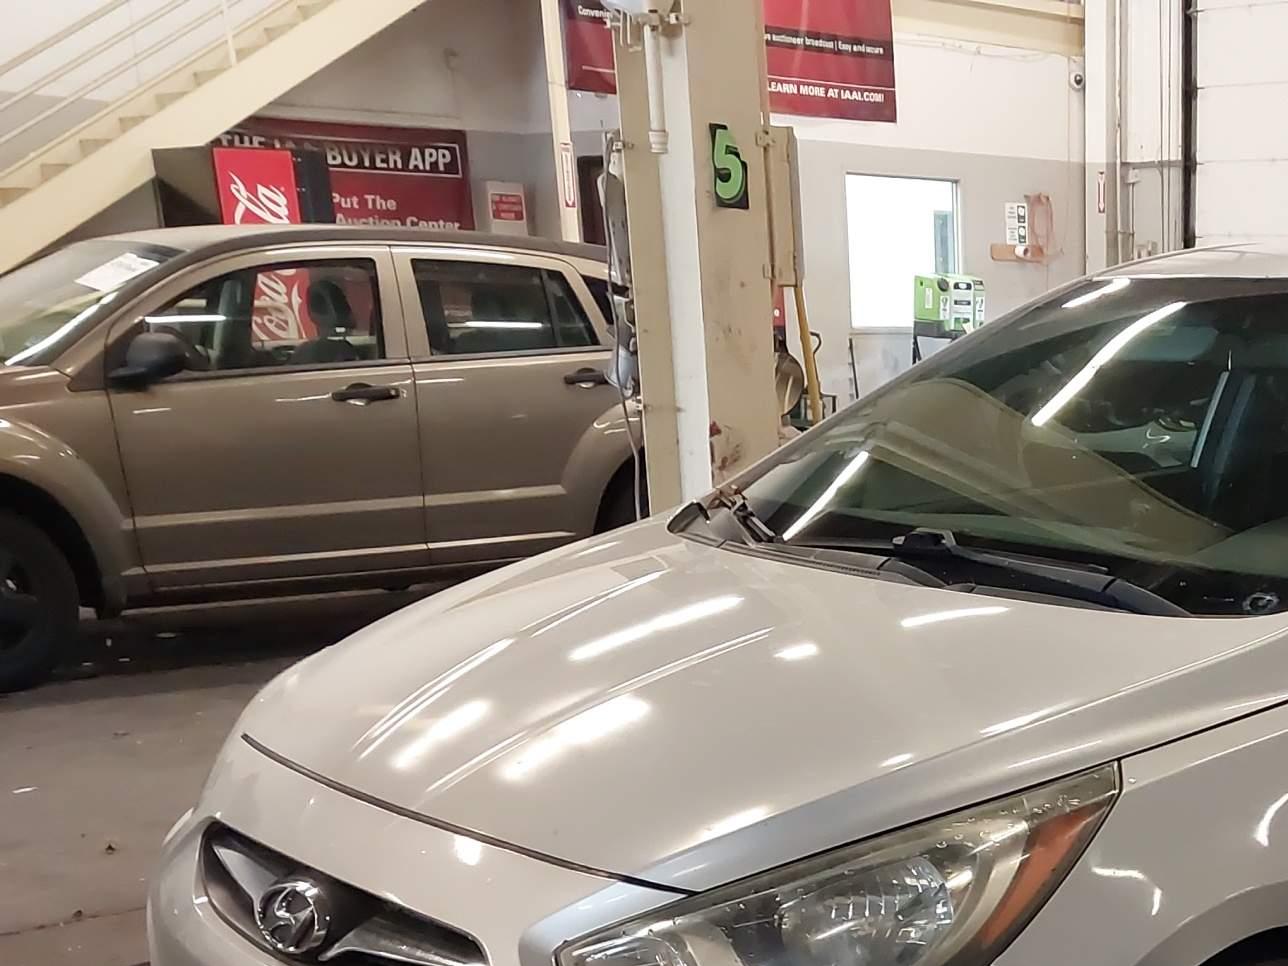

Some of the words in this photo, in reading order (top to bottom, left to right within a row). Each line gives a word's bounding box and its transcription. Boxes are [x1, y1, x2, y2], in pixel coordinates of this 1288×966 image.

[768, 81, 798, 94] LEARN
[800, 86, 826, 98] MORE
[827, 89, 840, 99] AT
[326, 144, 401, 169] BUYER
[407, 147, 452, 172] APP
[712, 126, 745, 200] 5
[364, 194, 397, 212] The
